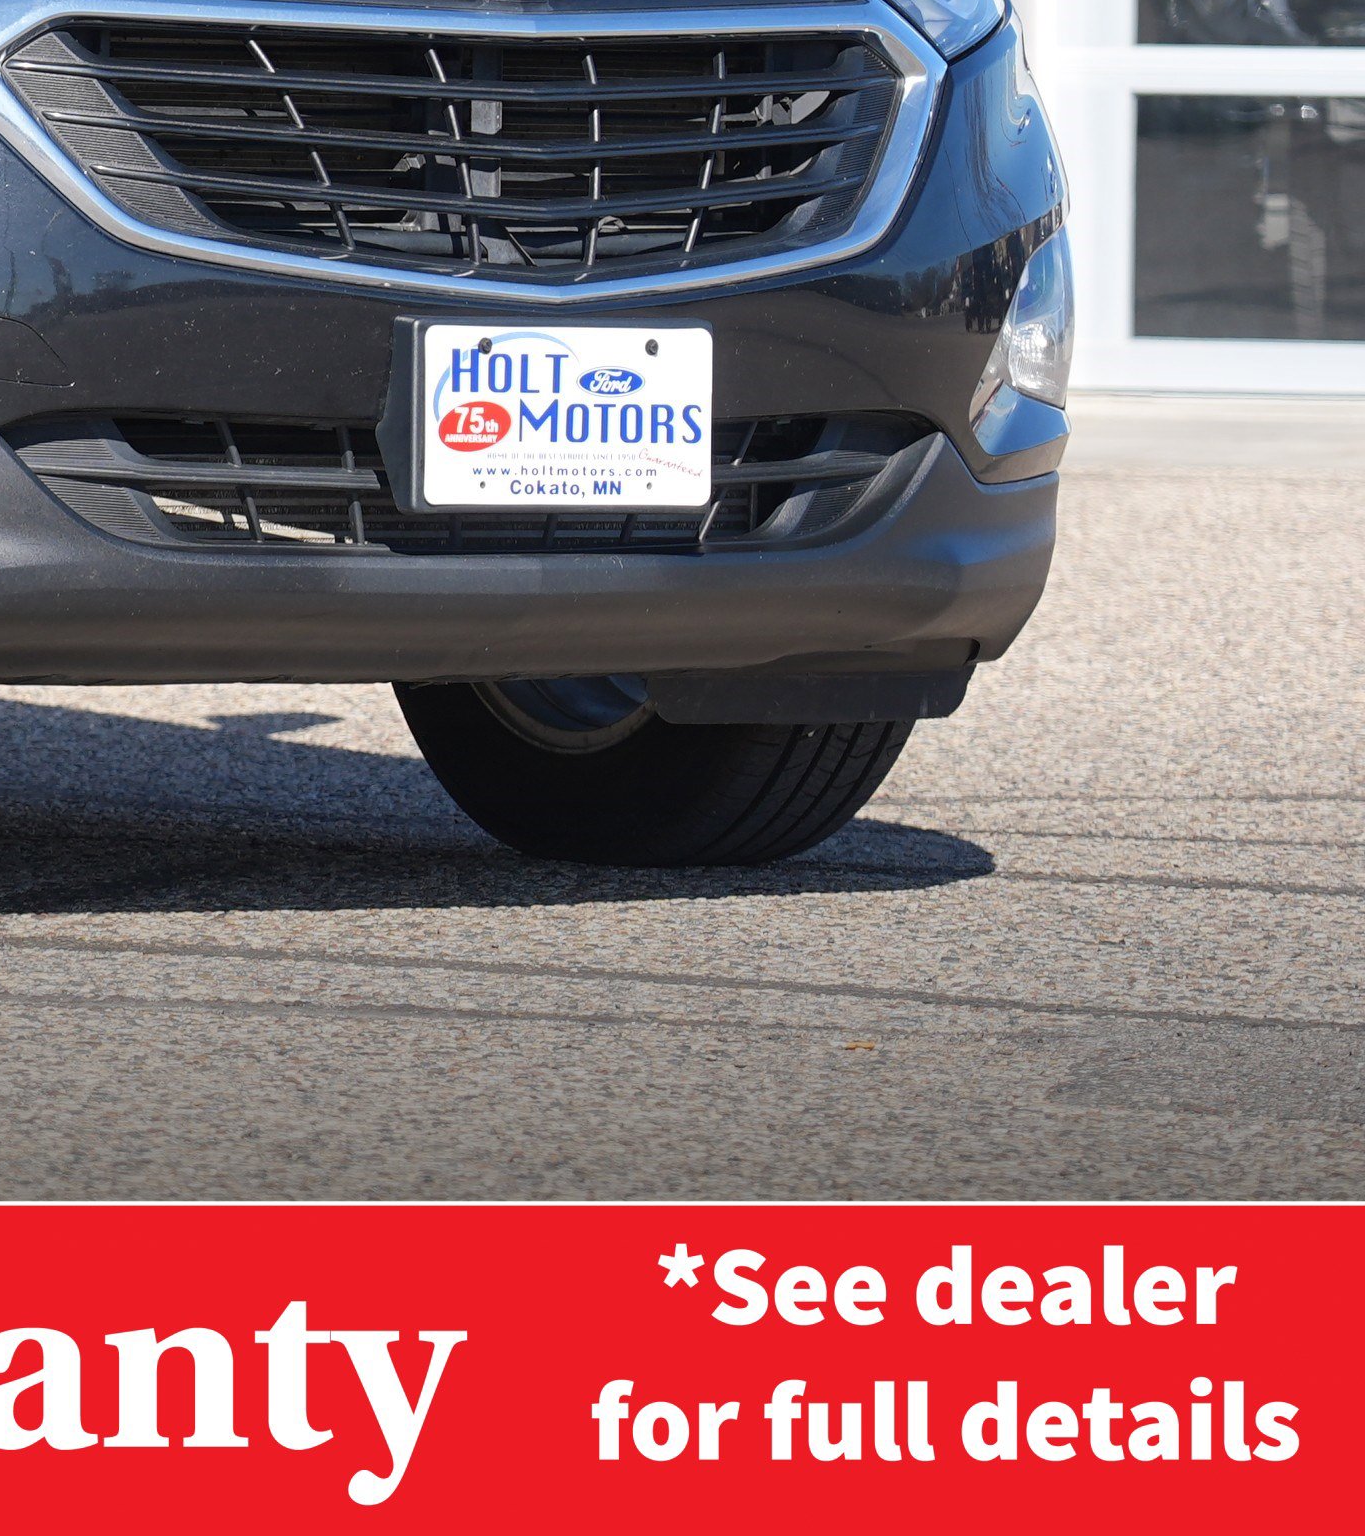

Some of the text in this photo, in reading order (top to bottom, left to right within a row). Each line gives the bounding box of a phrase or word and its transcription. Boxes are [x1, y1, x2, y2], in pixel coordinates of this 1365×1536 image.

[451, 348, 569, 395] HOLT
[590, 369, 632, 394] Ford
[454, 406, 500, 433] 75th
[519, 399, 702, 444] MOTORS
[444, 433, 498, 444] ANNIVERSARY
[472, 465, 657, 477] www.holtmotors.com
[510, 479, 622, 498] Cokato, MN
